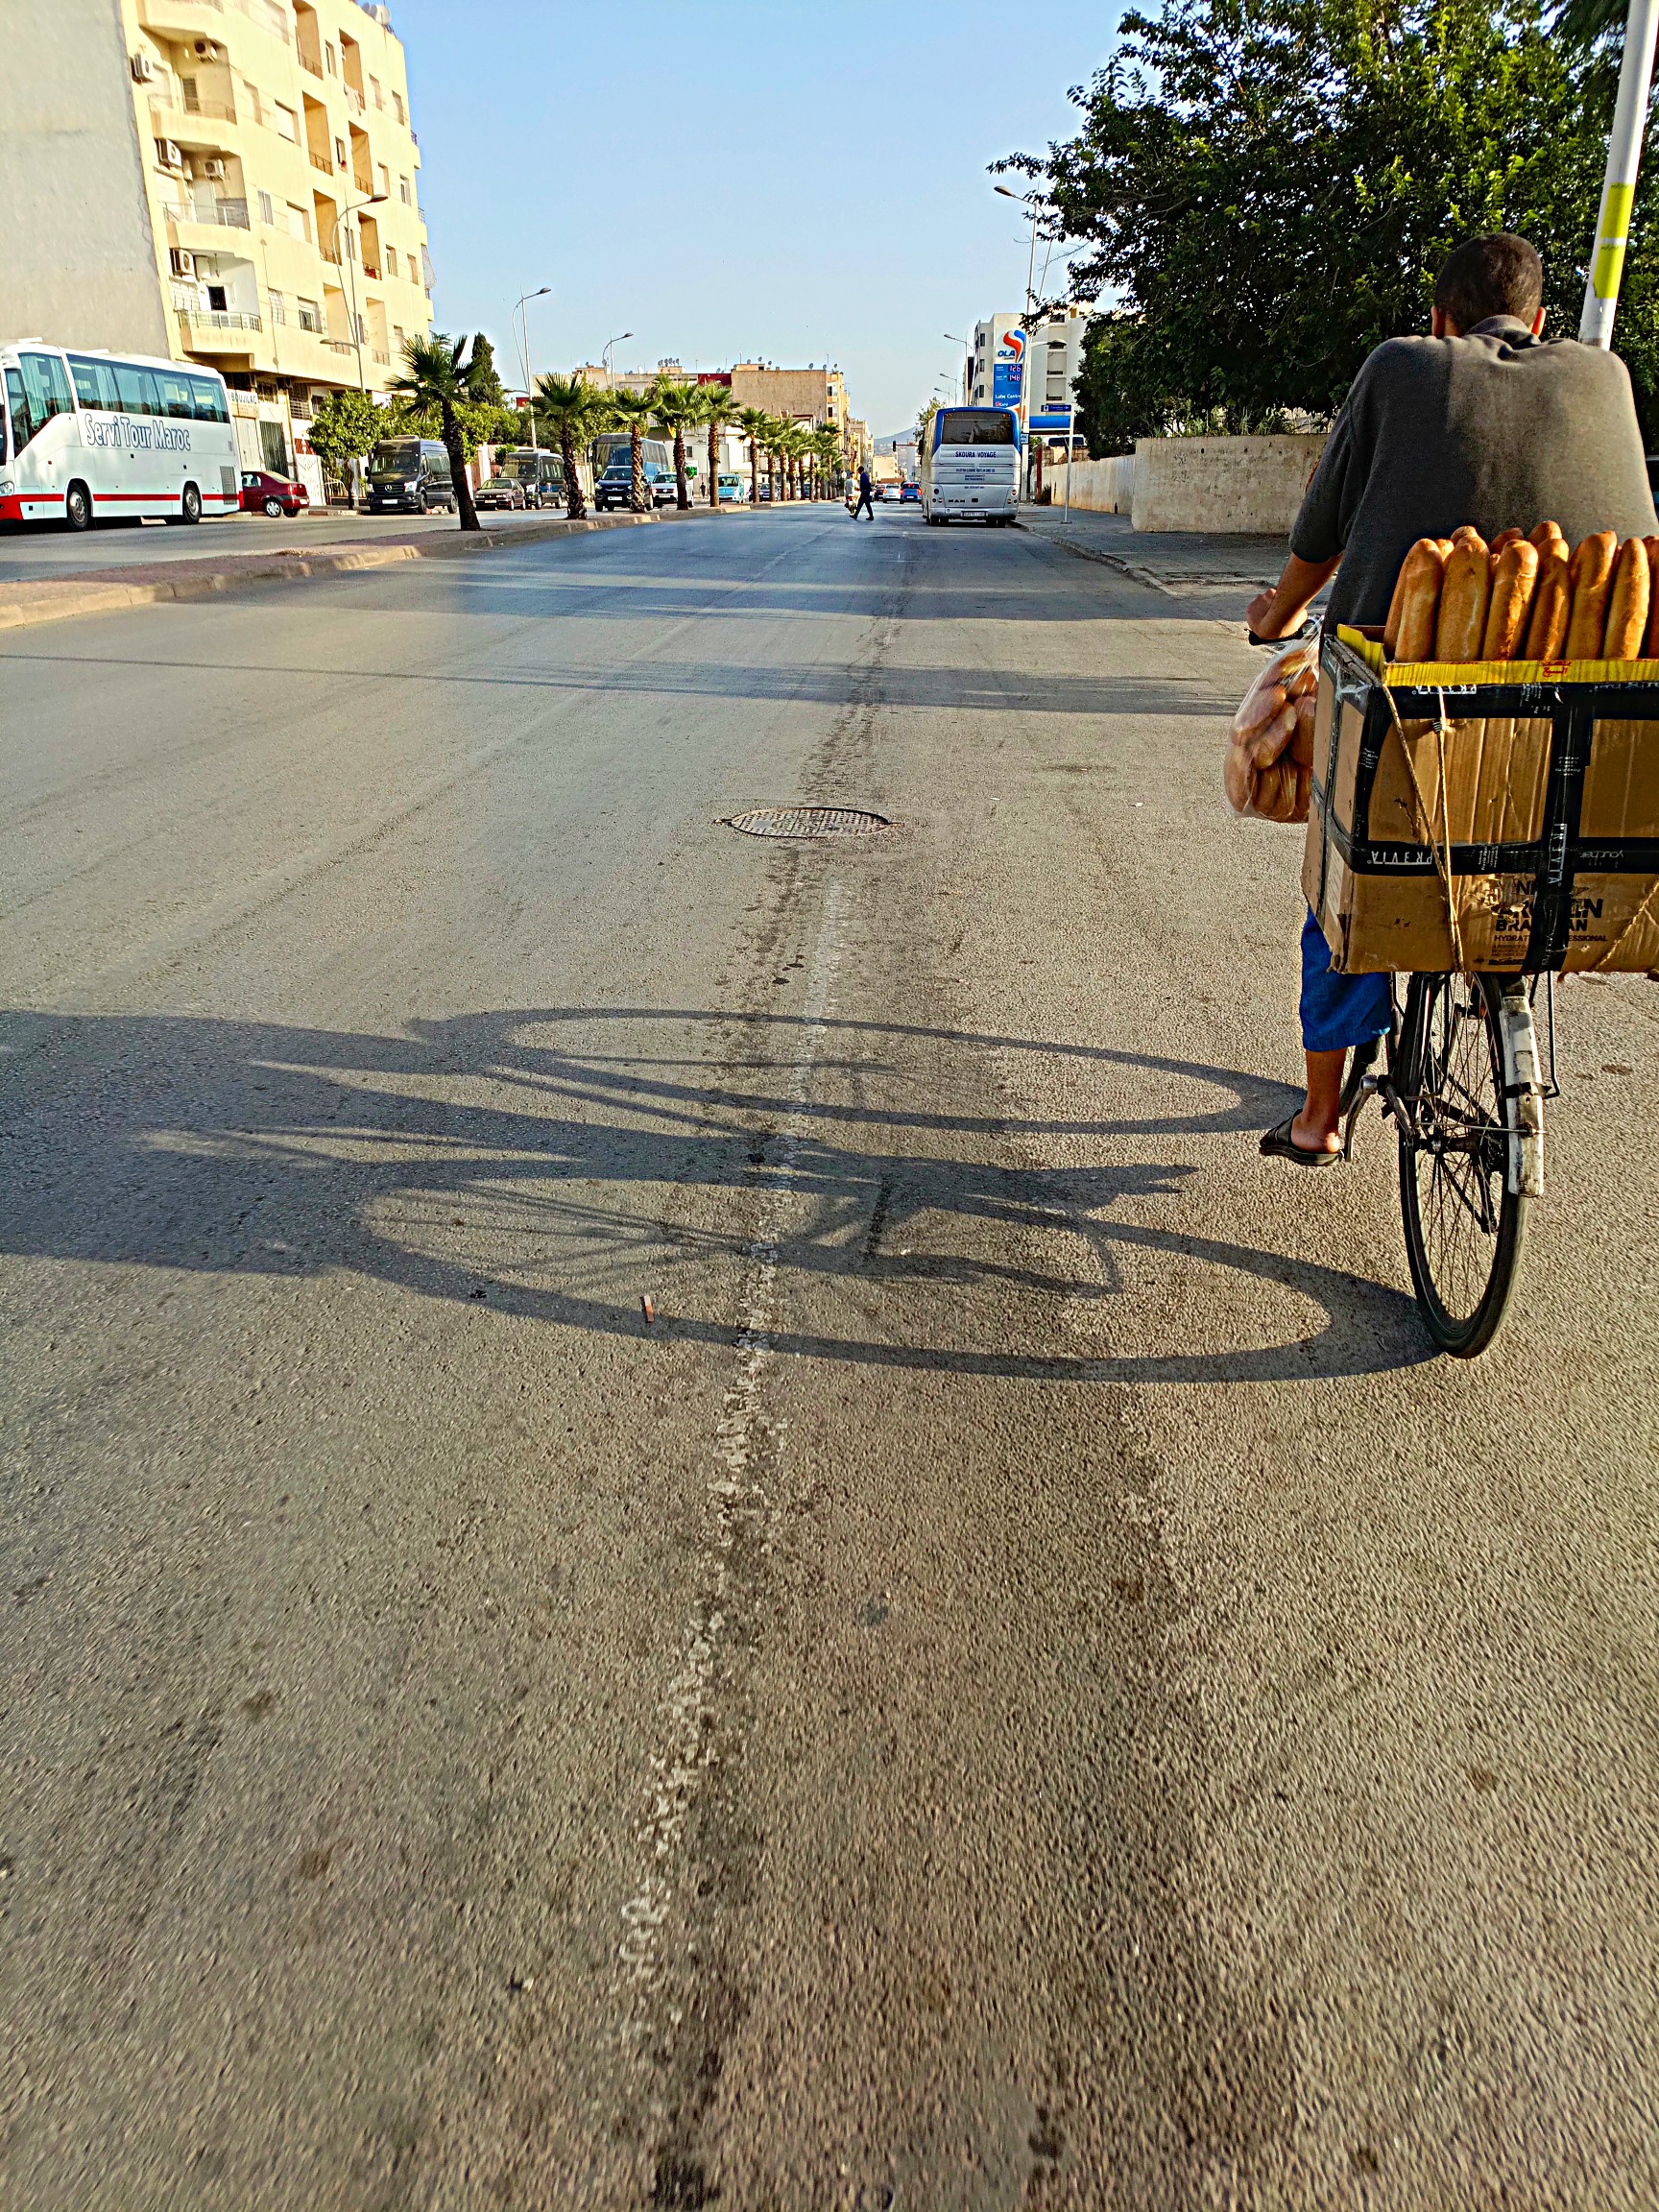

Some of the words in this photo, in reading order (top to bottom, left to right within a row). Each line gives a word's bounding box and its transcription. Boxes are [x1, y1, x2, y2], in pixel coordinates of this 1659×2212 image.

[84, 413, 121, 446] Servi
[120, 417, 152, 449] Tour
[153, 420, 191, 451] Maroc
